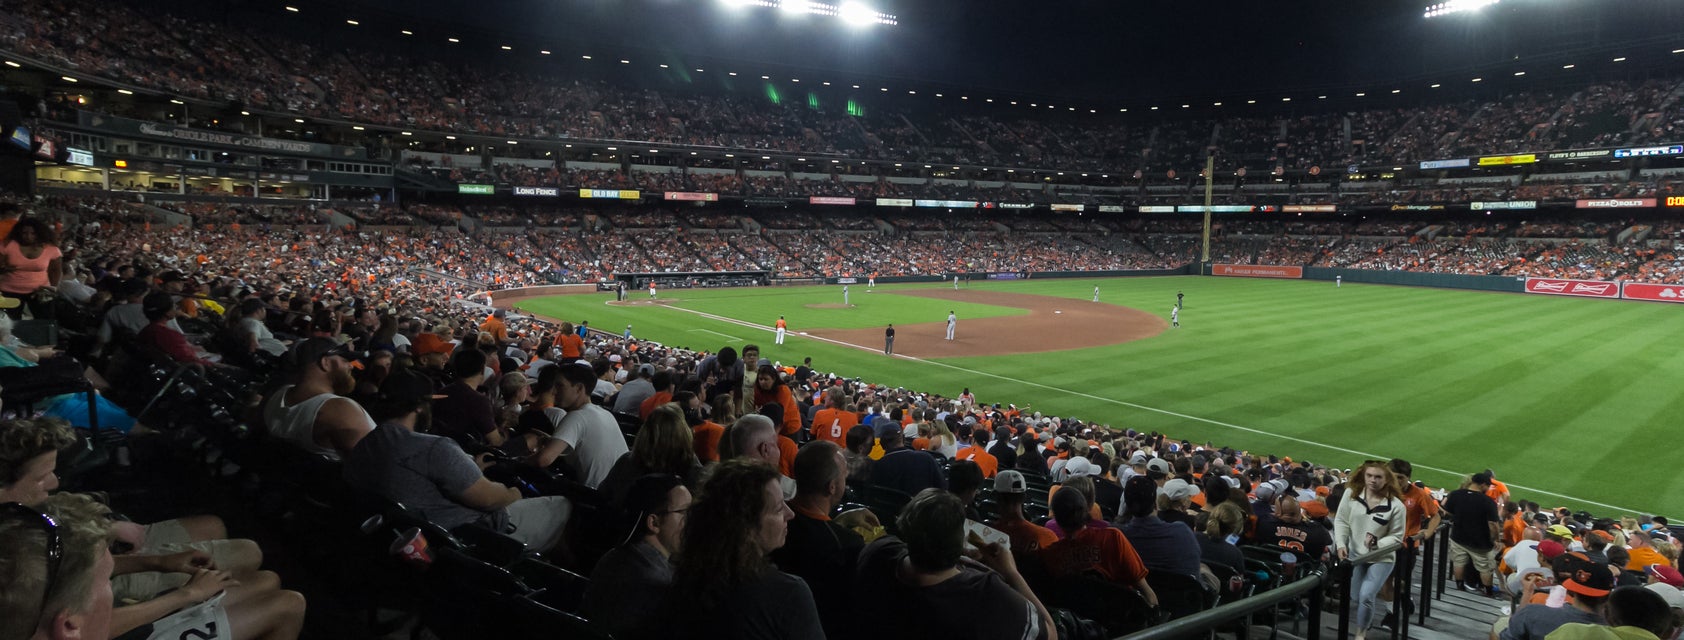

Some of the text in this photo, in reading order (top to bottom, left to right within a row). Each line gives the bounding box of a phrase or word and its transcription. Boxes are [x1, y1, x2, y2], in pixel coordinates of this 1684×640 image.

[173, 129, 208, 141] ORIOLE
[208, 133, 234, 144] PARK
[241, 137, 281, 150] CAMDEN
[281, 141, 311, 152] YARDS
[516, 187, 556, 196] LONG FENCE
[593, 190, 606, 198] OLD
[606, 190, 619, 198] BAY
[831, 418, 841, 438] 6
[1275, 526, 1308, 541] JONES
